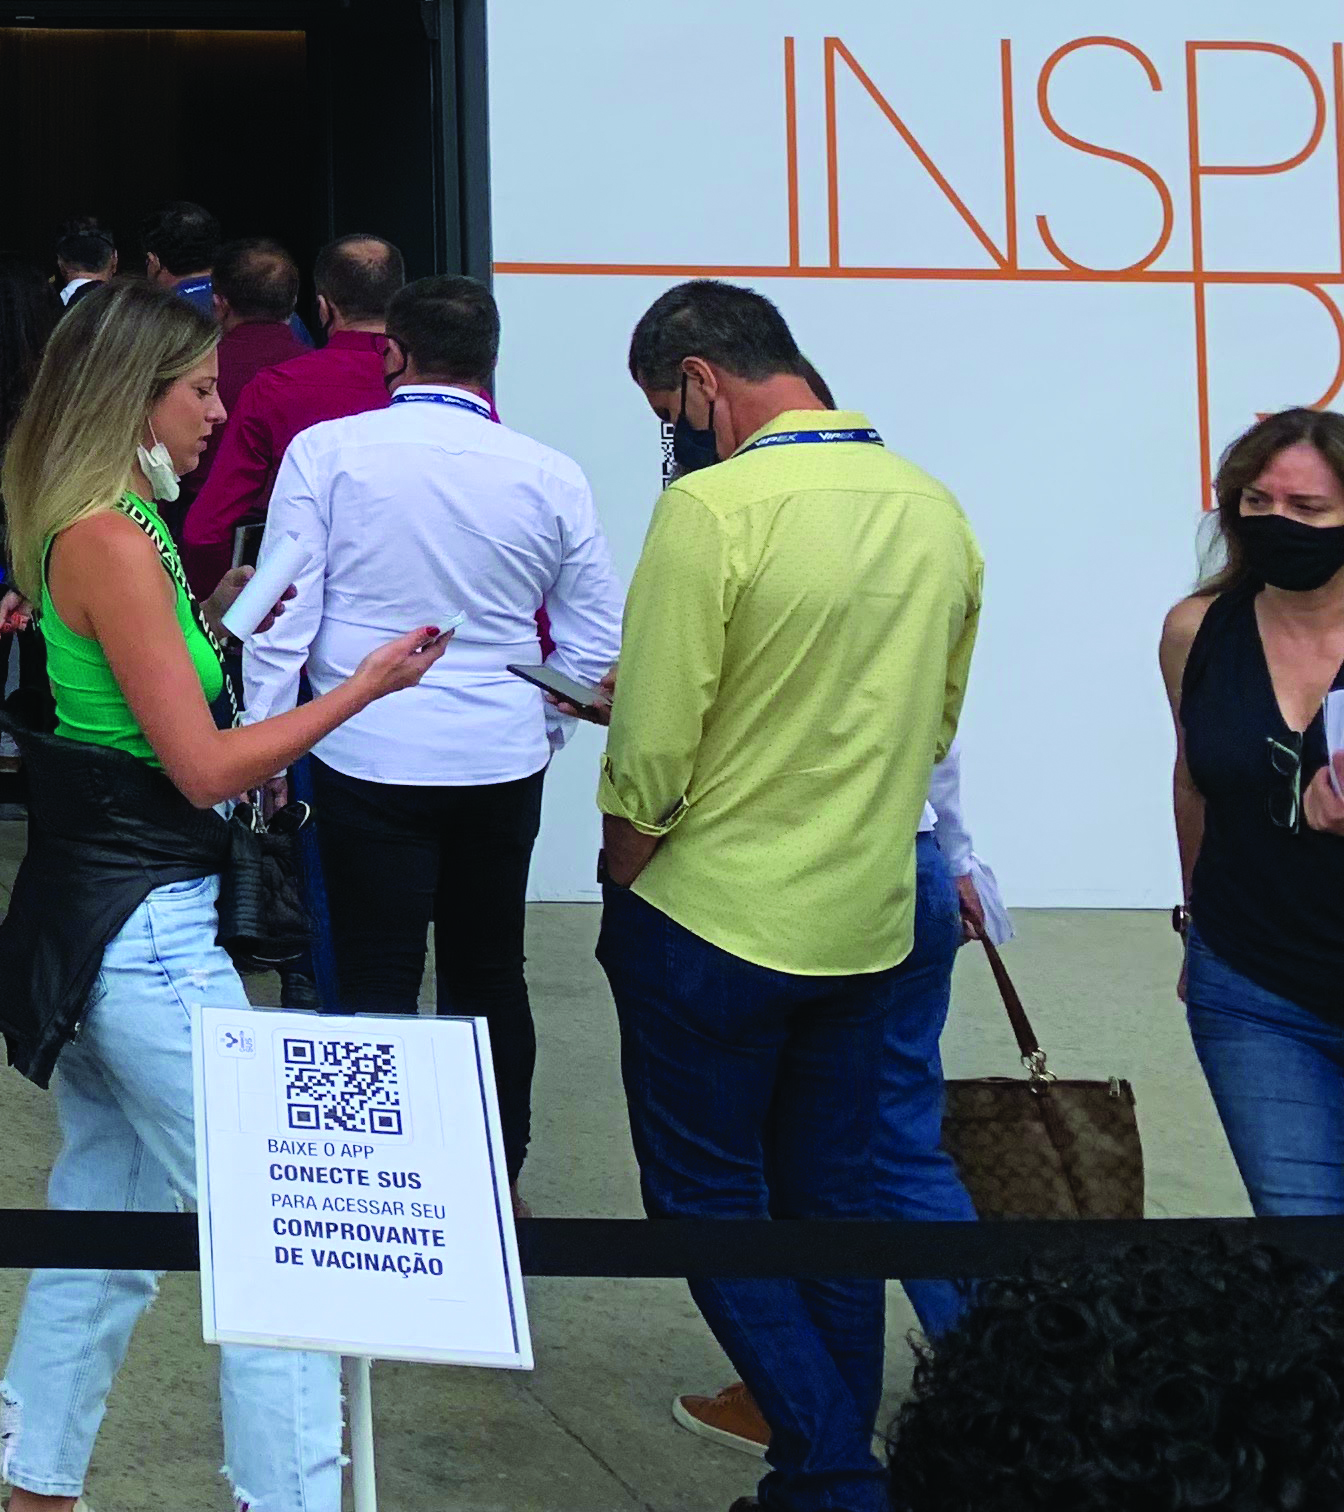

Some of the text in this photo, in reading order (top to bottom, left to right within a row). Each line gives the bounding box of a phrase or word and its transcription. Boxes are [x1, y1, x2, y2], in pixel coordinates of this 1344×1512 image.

[267, 1138, 374, 1159] BAIXE O APP
[269, 1163, 422, 1190] CONECTE SUS
[271, 1193, 446, 1220] PARA ACESSAR SEU
[273, 1217, 446, 1247] COMPROVANTE
[274, 1246, 444, 1279] DE VACINAÇÃO
